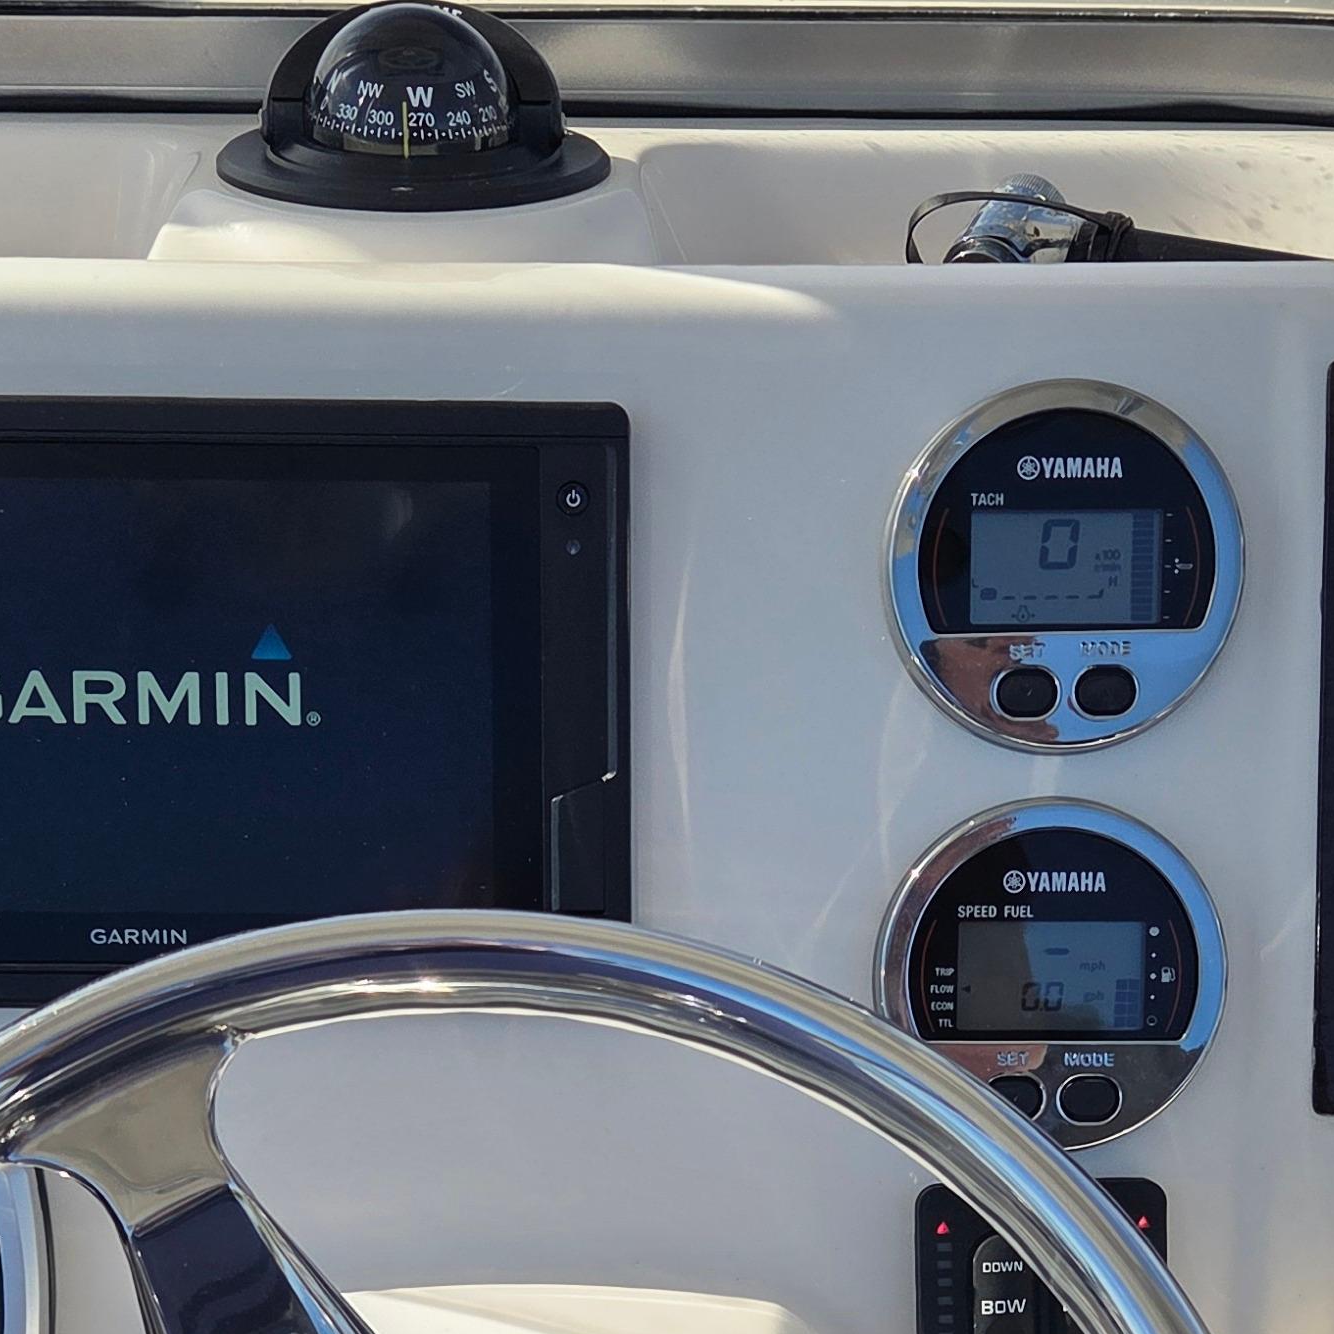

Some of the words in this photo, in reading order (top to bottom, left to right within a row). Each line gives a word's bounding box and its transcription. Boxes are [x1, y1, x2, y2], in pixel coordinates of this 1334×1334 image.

[357, 80, 384, 98] NW
[406, 86, 434, 108] W
[454, 80, 476, 98] SW
[483, 69, 498, 93] S
[336, 103, 357, 120] 330
[368, 110, 394, 126] 300
[408, 112, 435, 127] 270
[446, 110, 471, 127] 240
[1042, 456, 1123, 479] YAMAHA
[971, 493, 1004, 506] TACH
[1039, 518, 1081, 570] 0
[1027, 871, 1106, 893] YAMAHA
[957, 905, 997, 918] SPEED
[1004, 905, 1034, 918] FUEL
[90, 928, 187, 945] GARMIN
[935, 967, 954, 976] TRIP
[1079, 960, 1106, 973] mph
[930, 984, 954, 994] FLOW
[931, 1002, 954, 1011] ECON
[938, 1018, 954, 1029] TTL
[996, 1052, 1028, 1066] SET
[1064, 1052, 1115, 1067] MODE
[982, 1261, 1024, 1273] DOWN
[981, 1299, 1027, 1315] BOW
